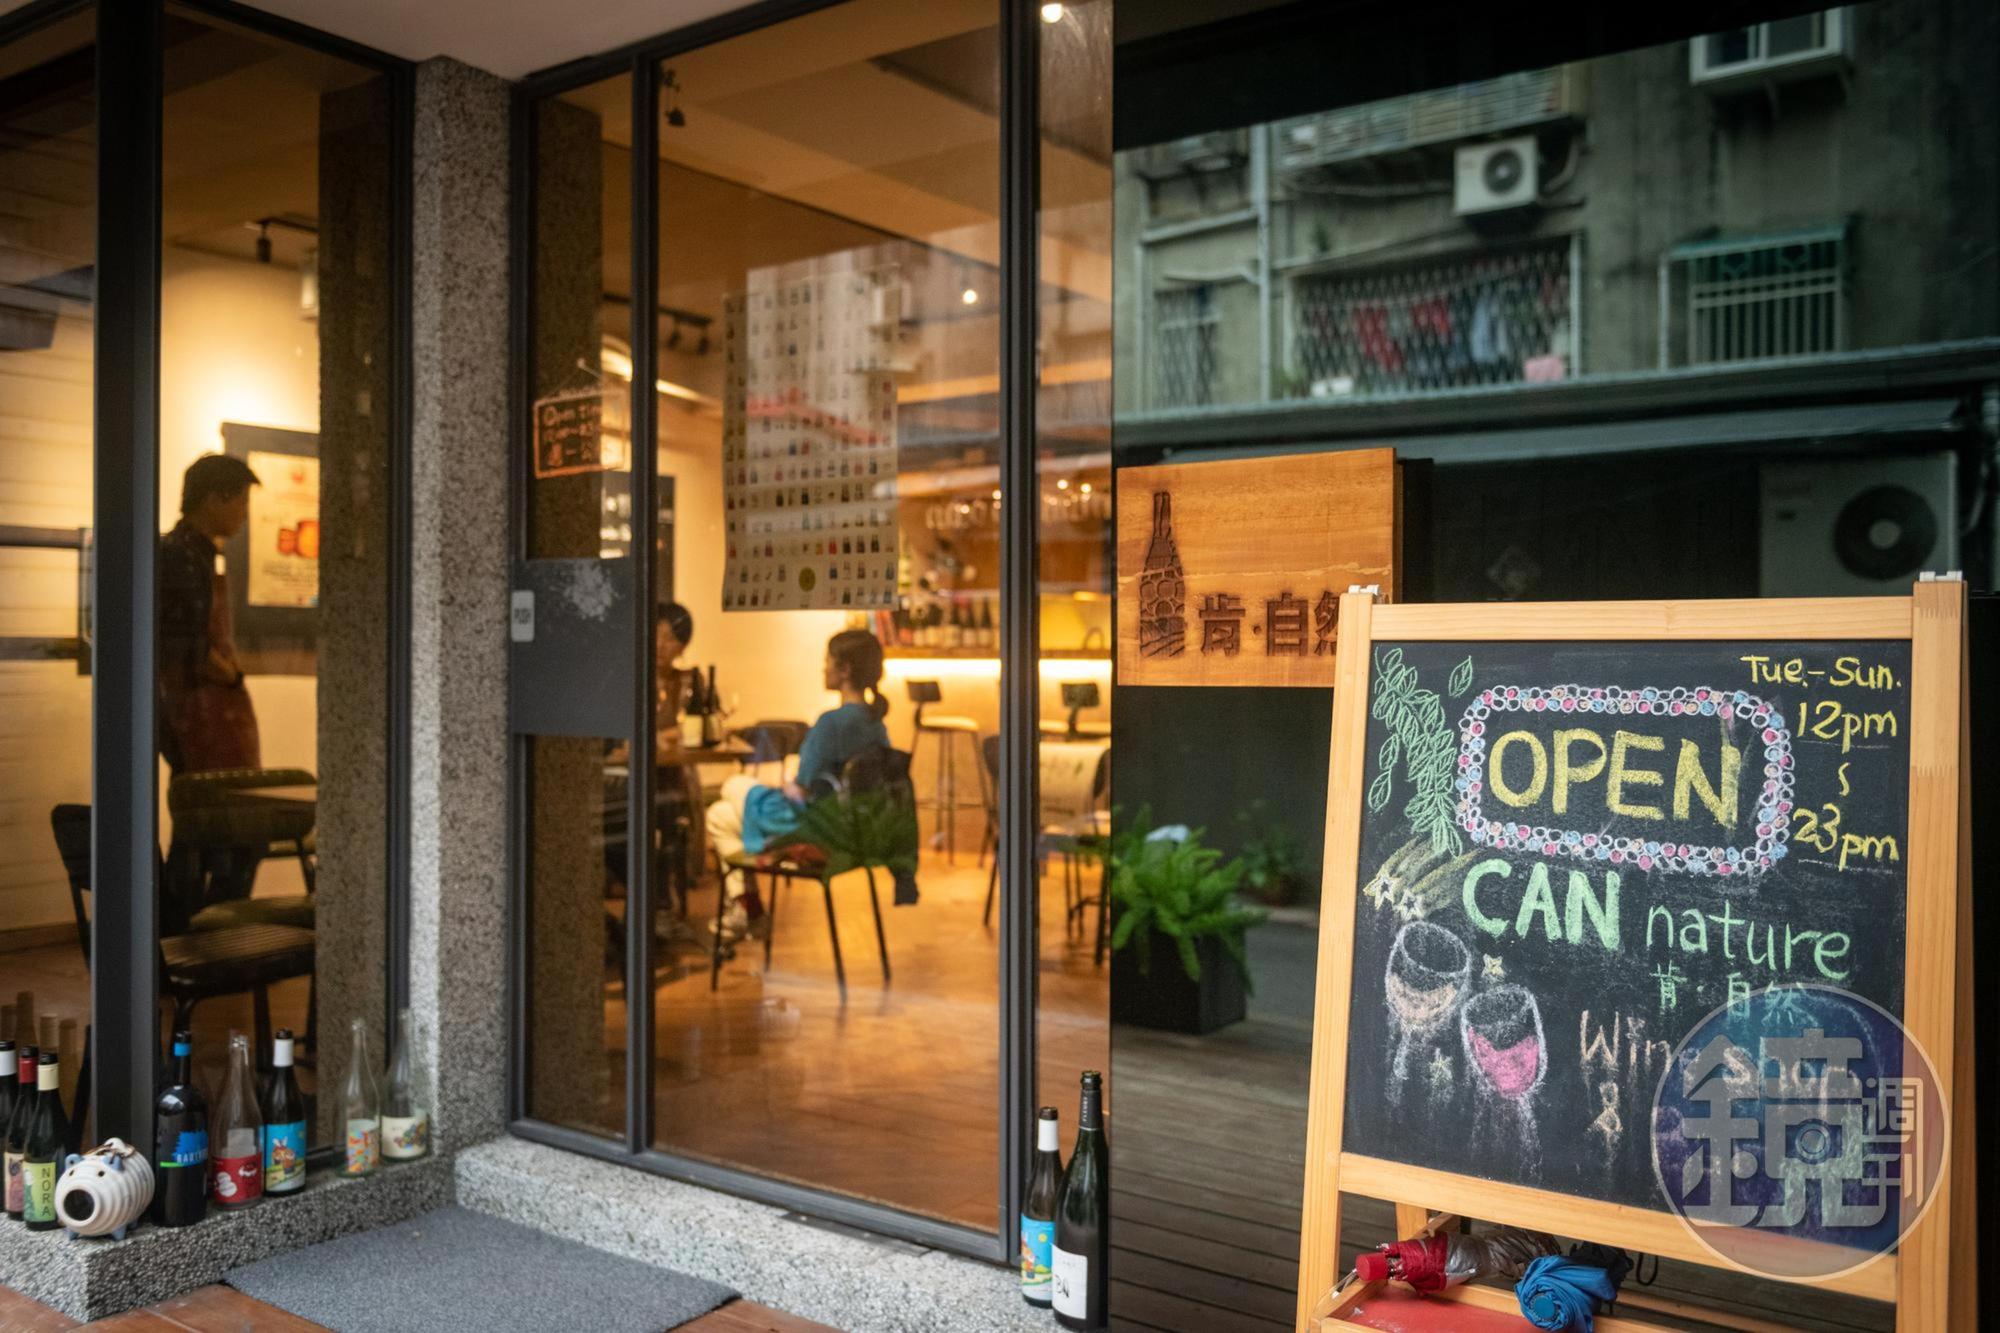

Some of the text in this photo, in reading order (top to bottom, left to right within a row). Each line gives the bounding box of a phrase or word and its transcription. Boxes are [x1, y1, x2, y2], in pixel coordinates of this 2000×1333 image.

[1797, 700, 1898, 754] 12pm
[1488, 727, 1742, 830] OPEN
[1792, 803, 1900, 872] 23pm
[1462, 858, 1851, 980] CAN nature
[41, 1167, 51, 1217] NORA
